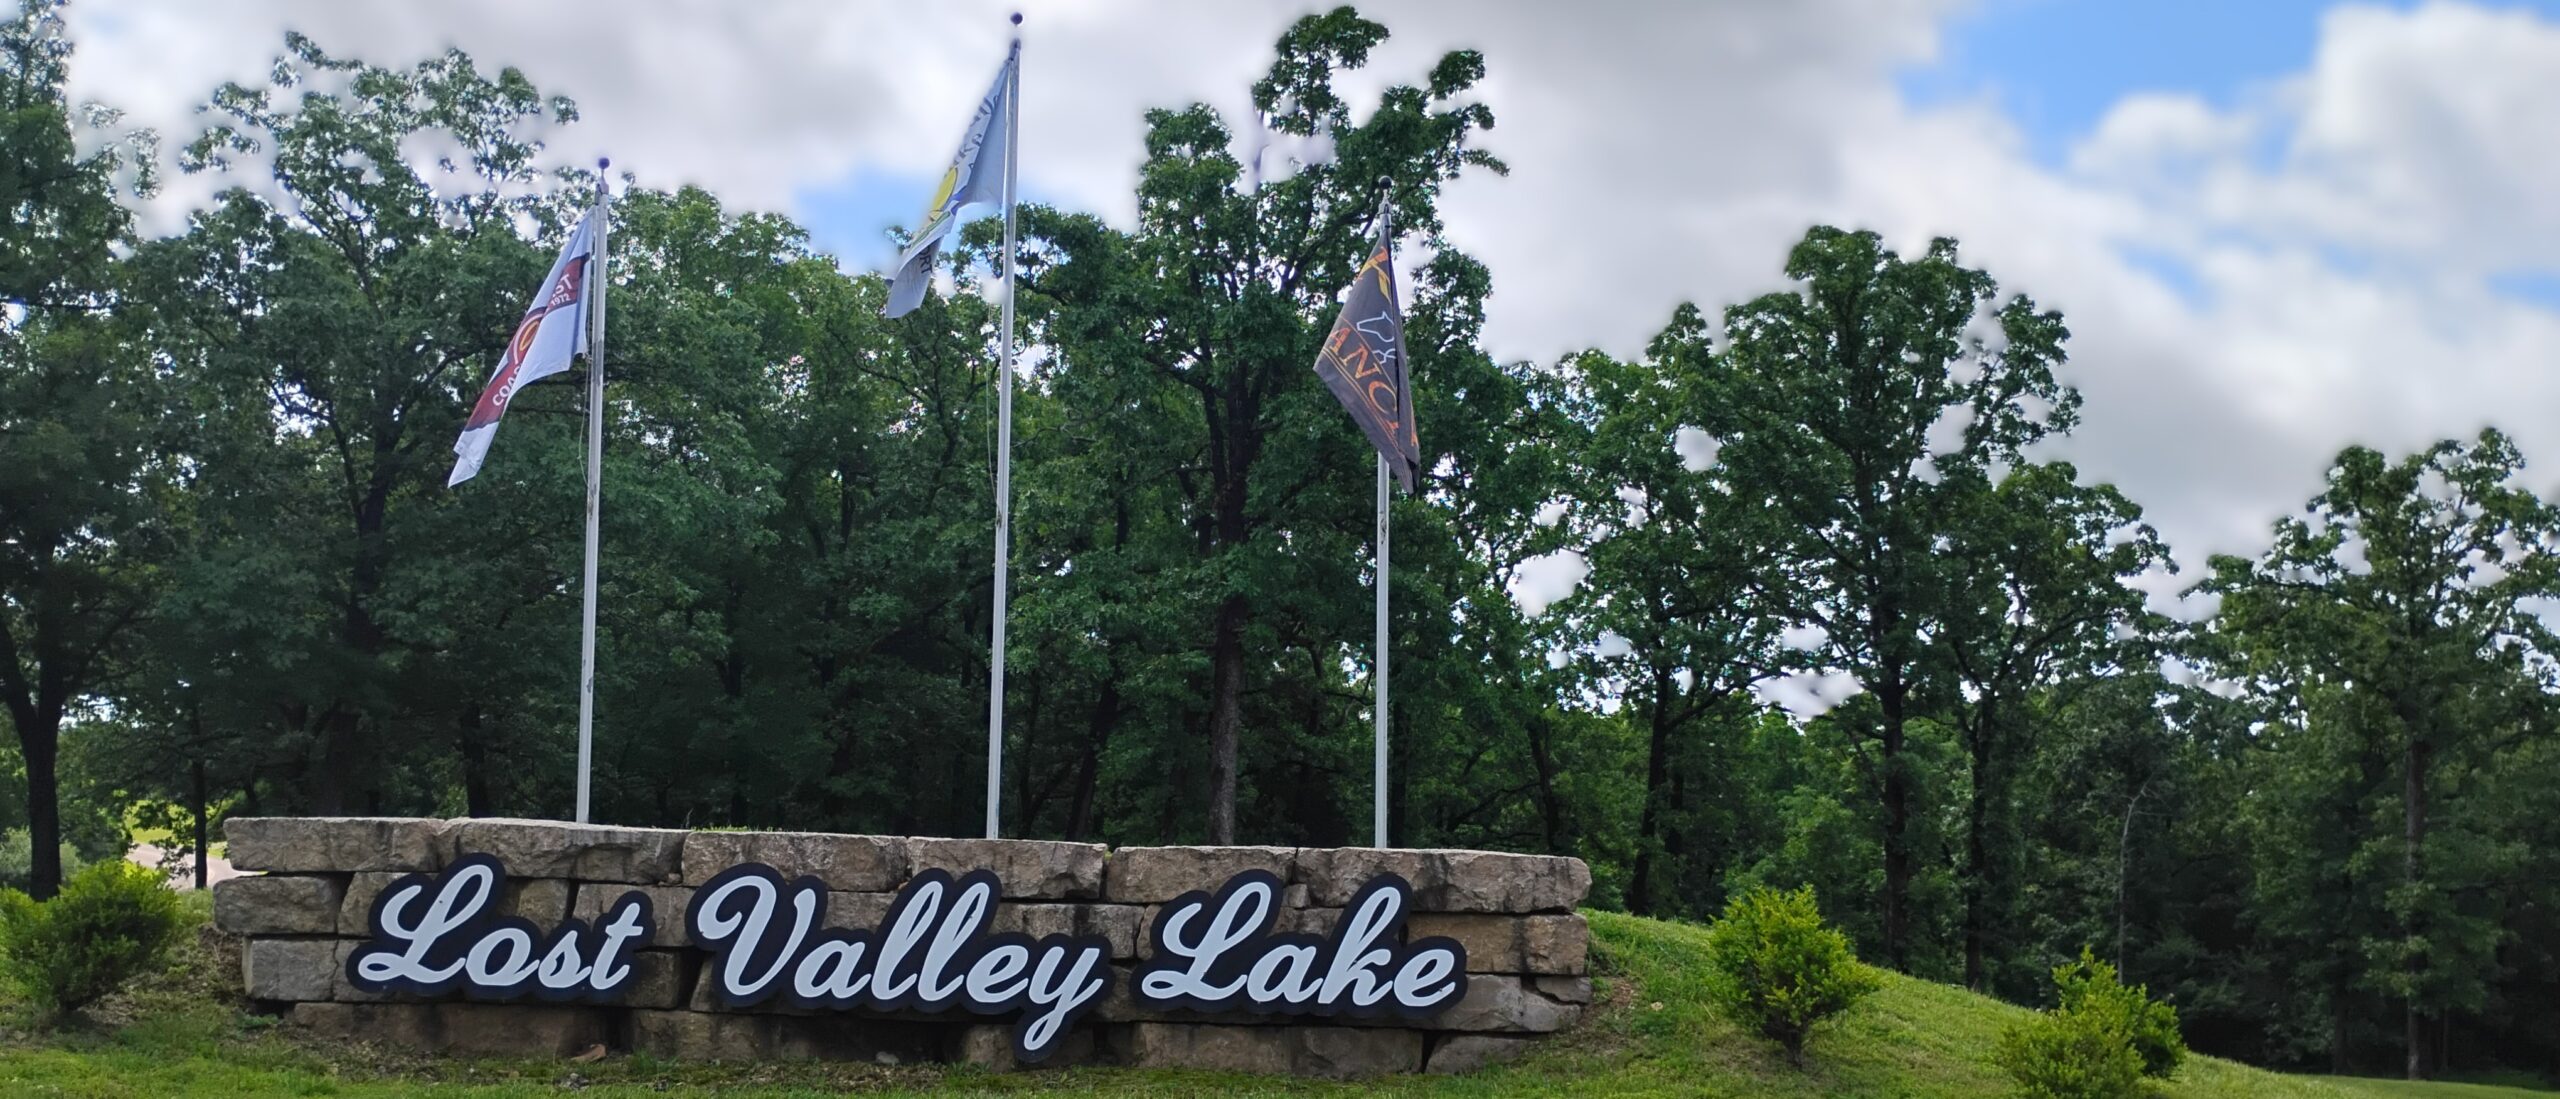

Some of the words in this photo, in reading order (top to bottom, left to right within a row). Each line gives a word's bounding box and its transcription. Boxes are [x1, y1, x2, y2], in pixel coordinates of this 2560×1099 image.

[550, 293, 571, 306] 1972
[1328, 326, 1399, 432] ANC
[359, 865, 643, 989] Lost
[698, 876, 1103, 1050] Valley
[1142, 882, 1455, 1006] Lake
